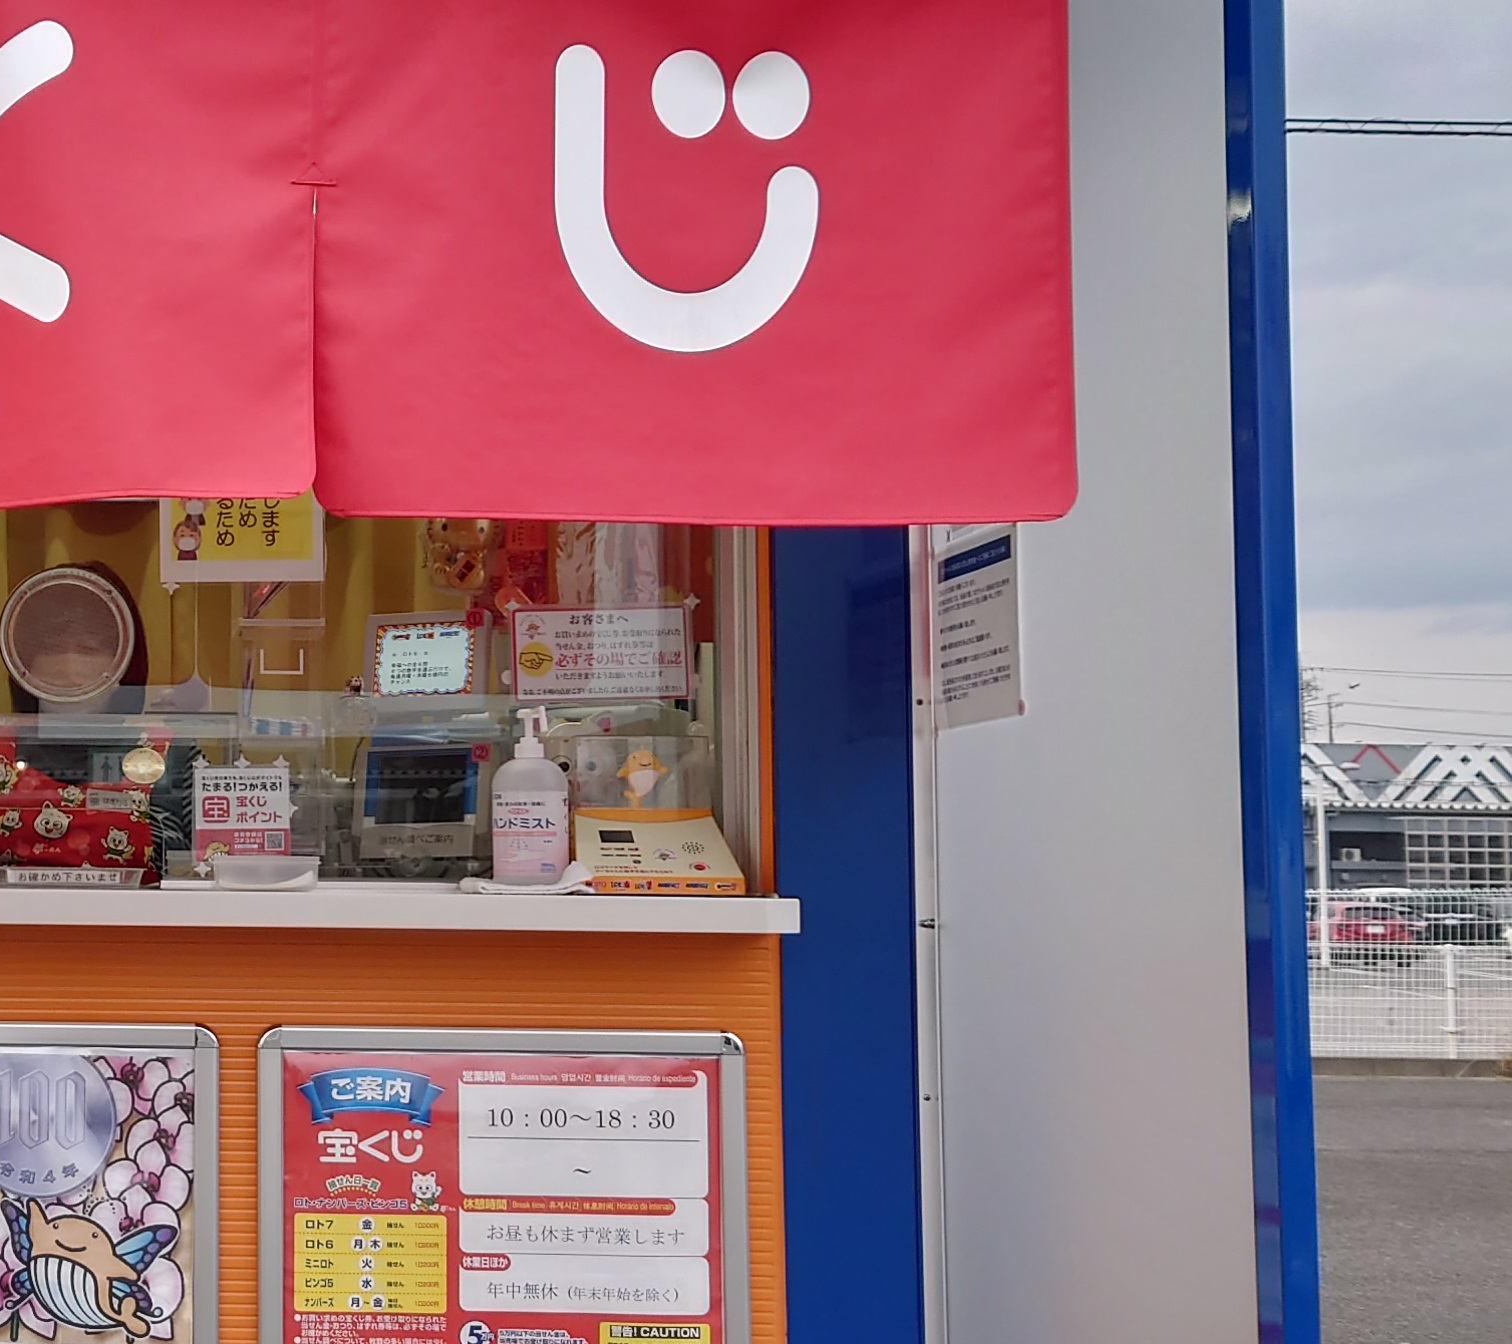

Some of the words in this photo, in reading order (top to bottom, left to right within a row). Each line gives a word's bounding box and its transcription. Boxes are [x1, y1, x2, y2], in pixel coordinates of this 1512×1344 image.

[569, 613, 629, 625] お客さまへ
[554, 651, 683, 668] 必ずその場でご確認
[201, 782, 283, 793] たまる!つかえる!
[236, 795, 268, 808] 宝くじ
[236, 811, 283, 824] ポイント
[18, 872, 119, 883] お確かめ下さいませ
[462, 1070, 506, 1083] 営業時間
[511, 1073, 539, 1081] Business
[539, 1073, 558, 1082] hours
[661, 1075, 697, 1084] expediente
[330, 1076, 412, 1105] ご案内
[317, 1128, 424, 1164] 宝くじ
[327, 1175, 381, 1191] 抽せん日一覧
[293, 1198, 408, 1210] ロト・ナンバーズ・ビンゴ5
[463, 1198, 508, 1211] 休憩時間
[512, 1200, 530, 1210] Break
[531, 1201, 546, 1210] time
[305, 1219, 334, 1230] ロト7
[361, 1218, 373, 1230] 金
[486, 1223, 686, 1246] お昼も休まず営業します
[305, 1239, 334, 1249] ロト6
[353, 1238, 363, 1250] 月
[369, 1238, 381, 1250] 木
[305, 1258, 334, 1269] ミニロト
[361, 1258, 373, 1269] 火
[462, 1256, 509, 1269] 休業日ほか
[305, 1278, 334, 1288] ビンゴ5
[361, 1278, 373, 1289] 水
[486, 1281, 558, 1301] 年中無休
[568, 1287, 680, 1304] (年末年始を除く)
[304, 1297, 335, 1307] ナンバーズ
[610, 1325, 637, 1339] 警告!
[640, 1326, 700, 1339] CAUTION
